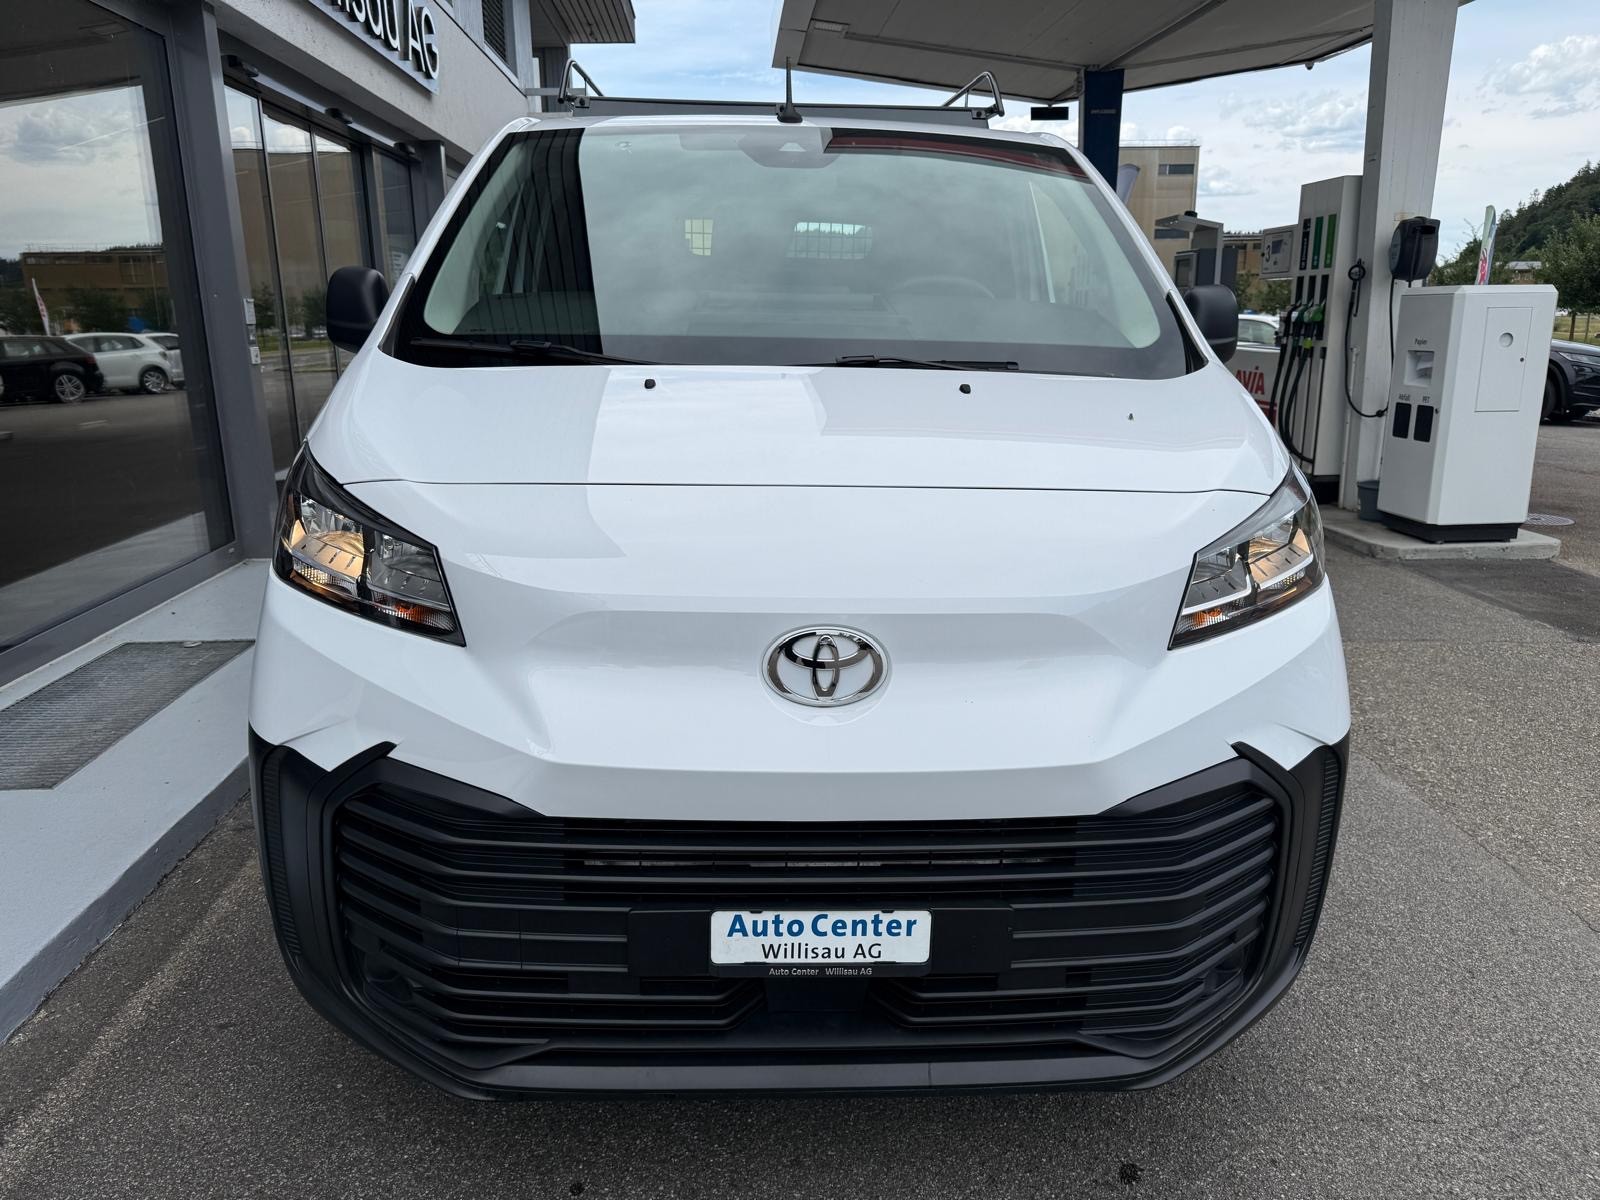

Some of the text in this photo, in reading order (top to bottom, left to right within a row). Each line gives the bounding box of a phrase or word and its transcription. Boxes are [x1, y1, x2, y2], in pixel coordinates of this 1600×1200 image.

[408, 0, 439, 80] AG
[727, 914, 918, 937] Auto Center
[761, 942, 882, 959] Willisau AG
[769, 967, 873, 976] Auto Center Willisau AG
